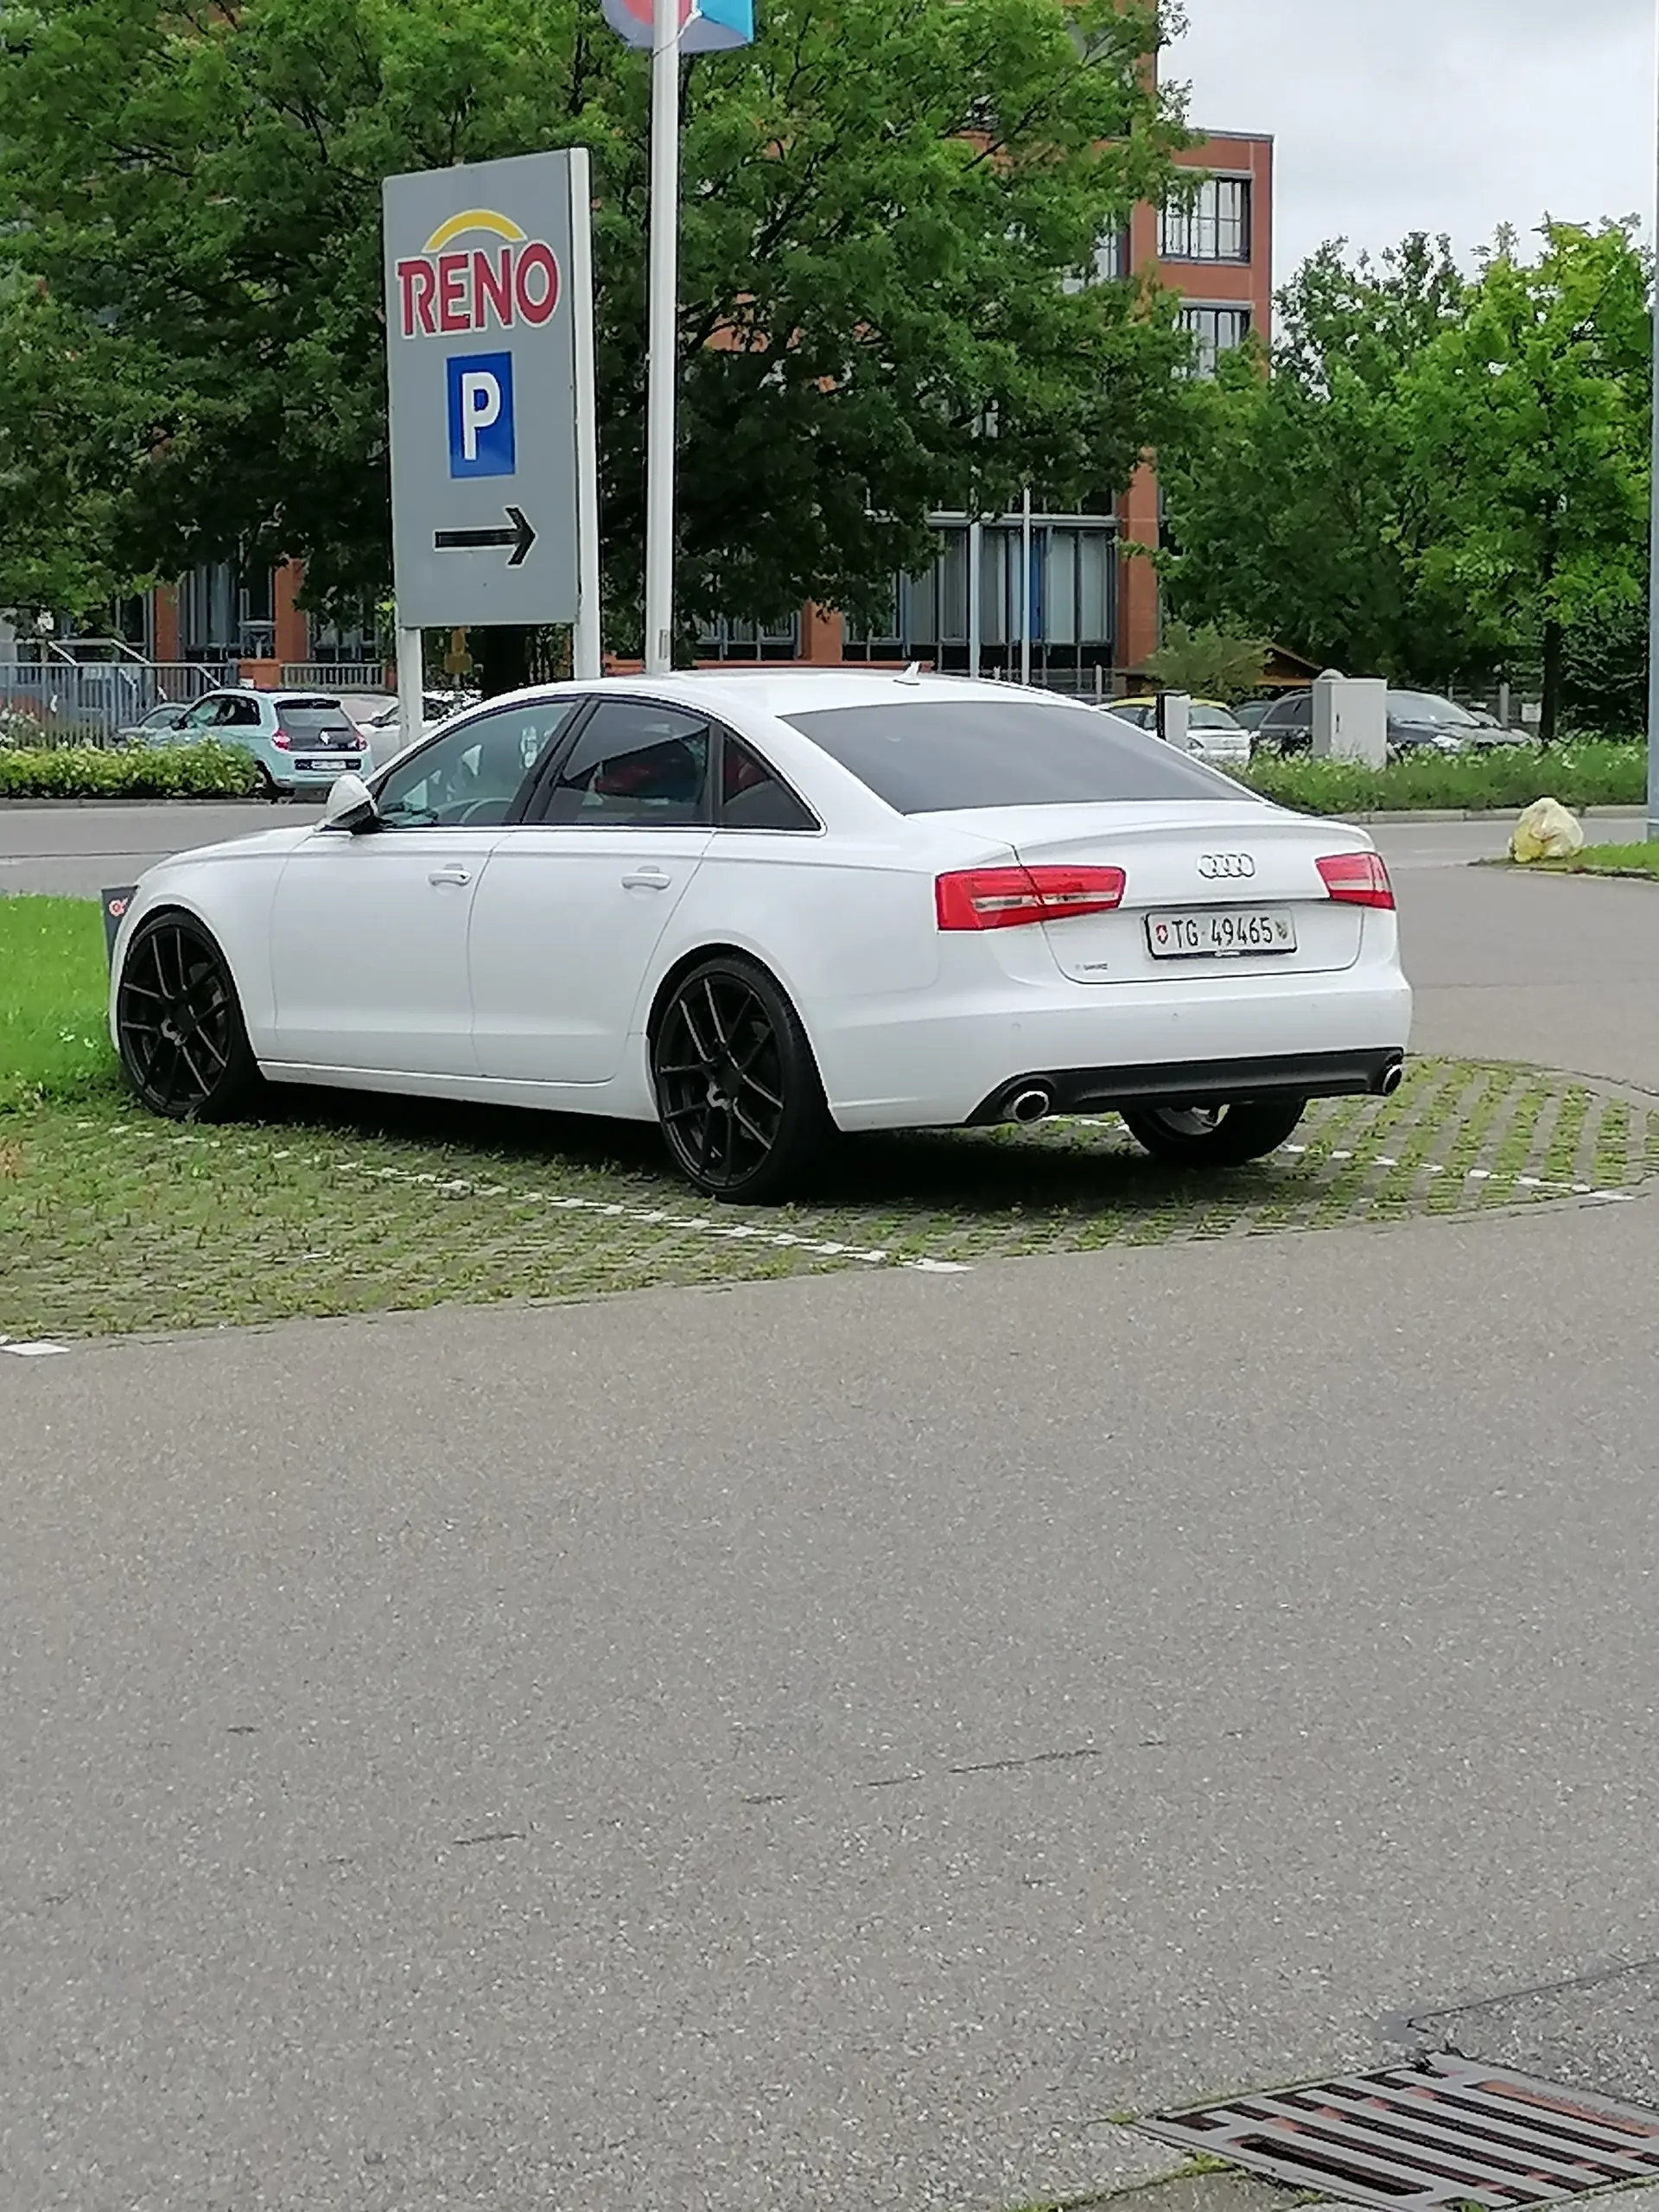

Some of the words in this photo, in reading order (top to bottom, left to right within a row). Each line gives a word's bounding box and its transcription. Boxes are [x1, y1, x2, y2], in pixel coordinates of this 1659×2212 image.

[397, 241, 560, 337] RENO
[461, 372, 501, 461] P
[1172, 918, 1198, 948] TG
[1211, 916, 1273, 945] 49465
